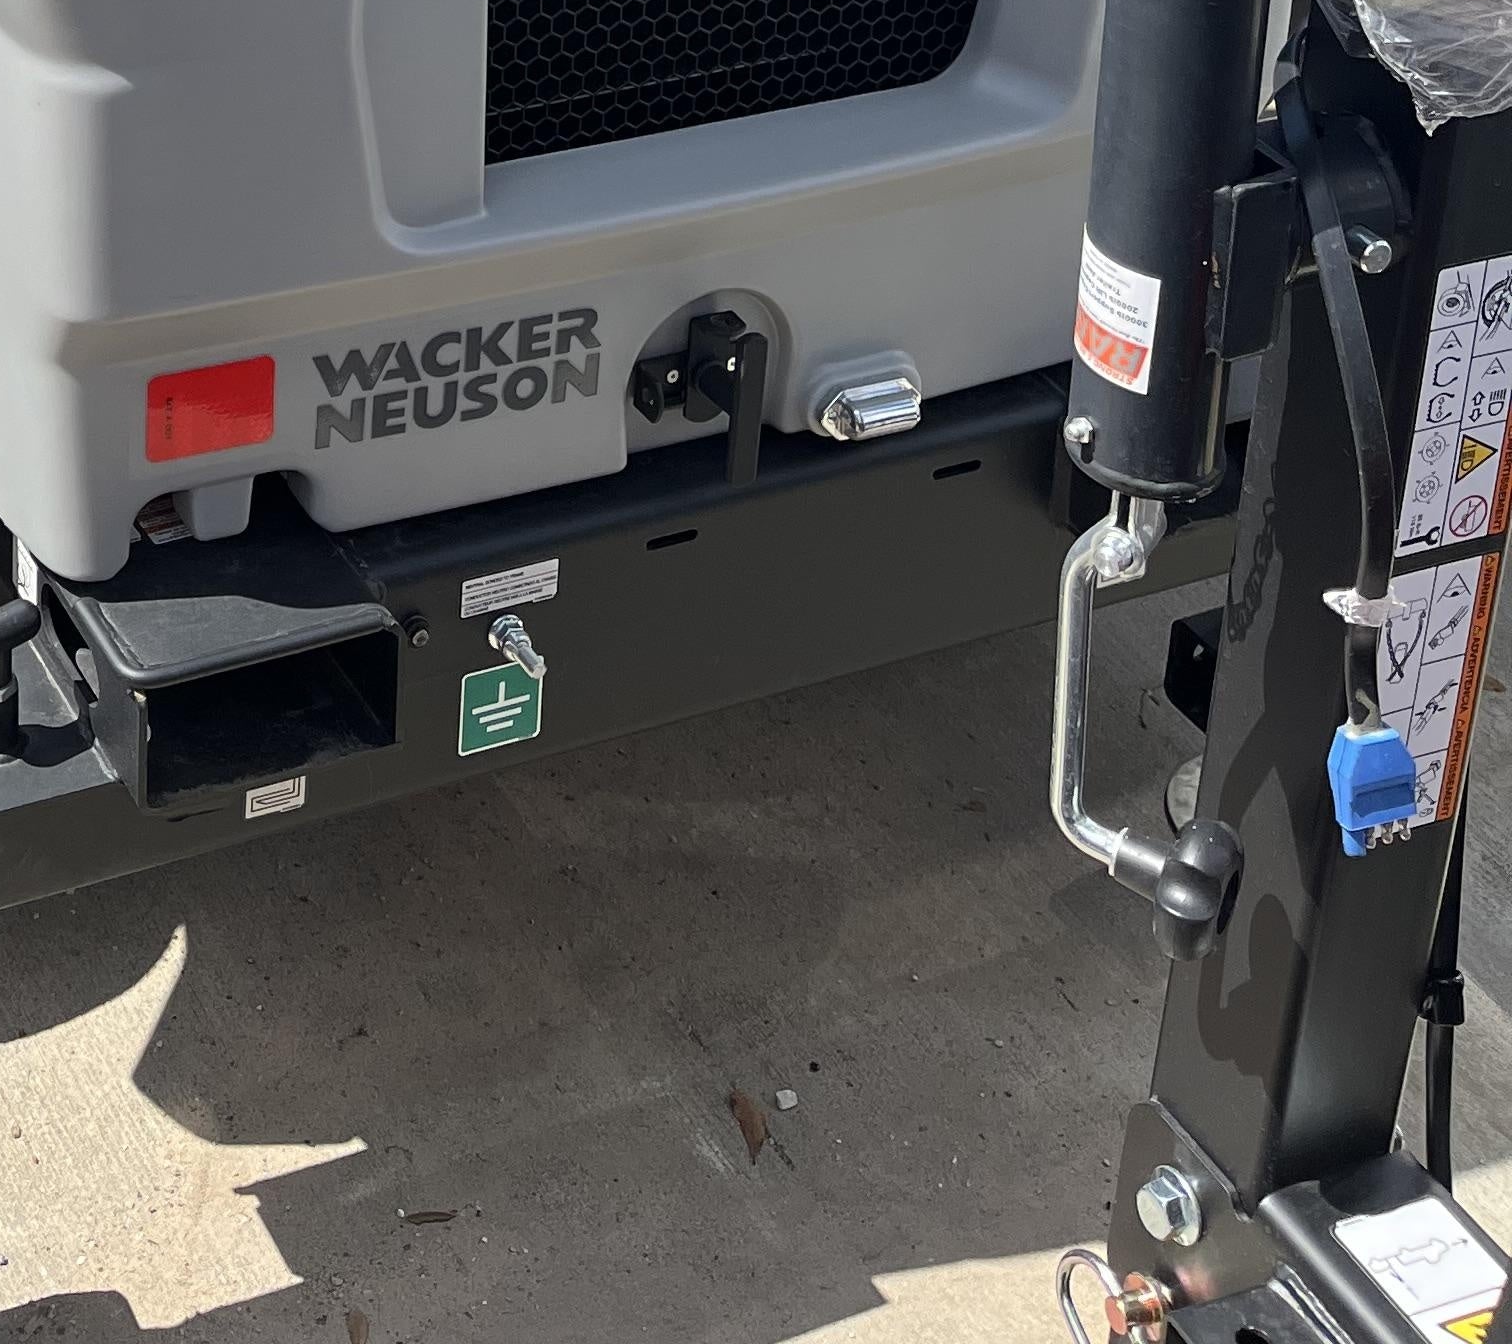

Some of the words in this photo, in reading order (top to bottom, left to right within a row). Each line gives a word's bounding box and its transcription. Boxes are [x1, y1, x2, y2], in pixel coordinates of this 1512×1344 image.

[312, 308, 601, 398] WACKER
[314, 352, 601, 450] NEUSON
[1476, 565, 1493, 620] WARNING
[1458, 636, 1481, 714] ADVERTENCIA
[1439, 729, 1464, 817] AVERTISSEMENT
